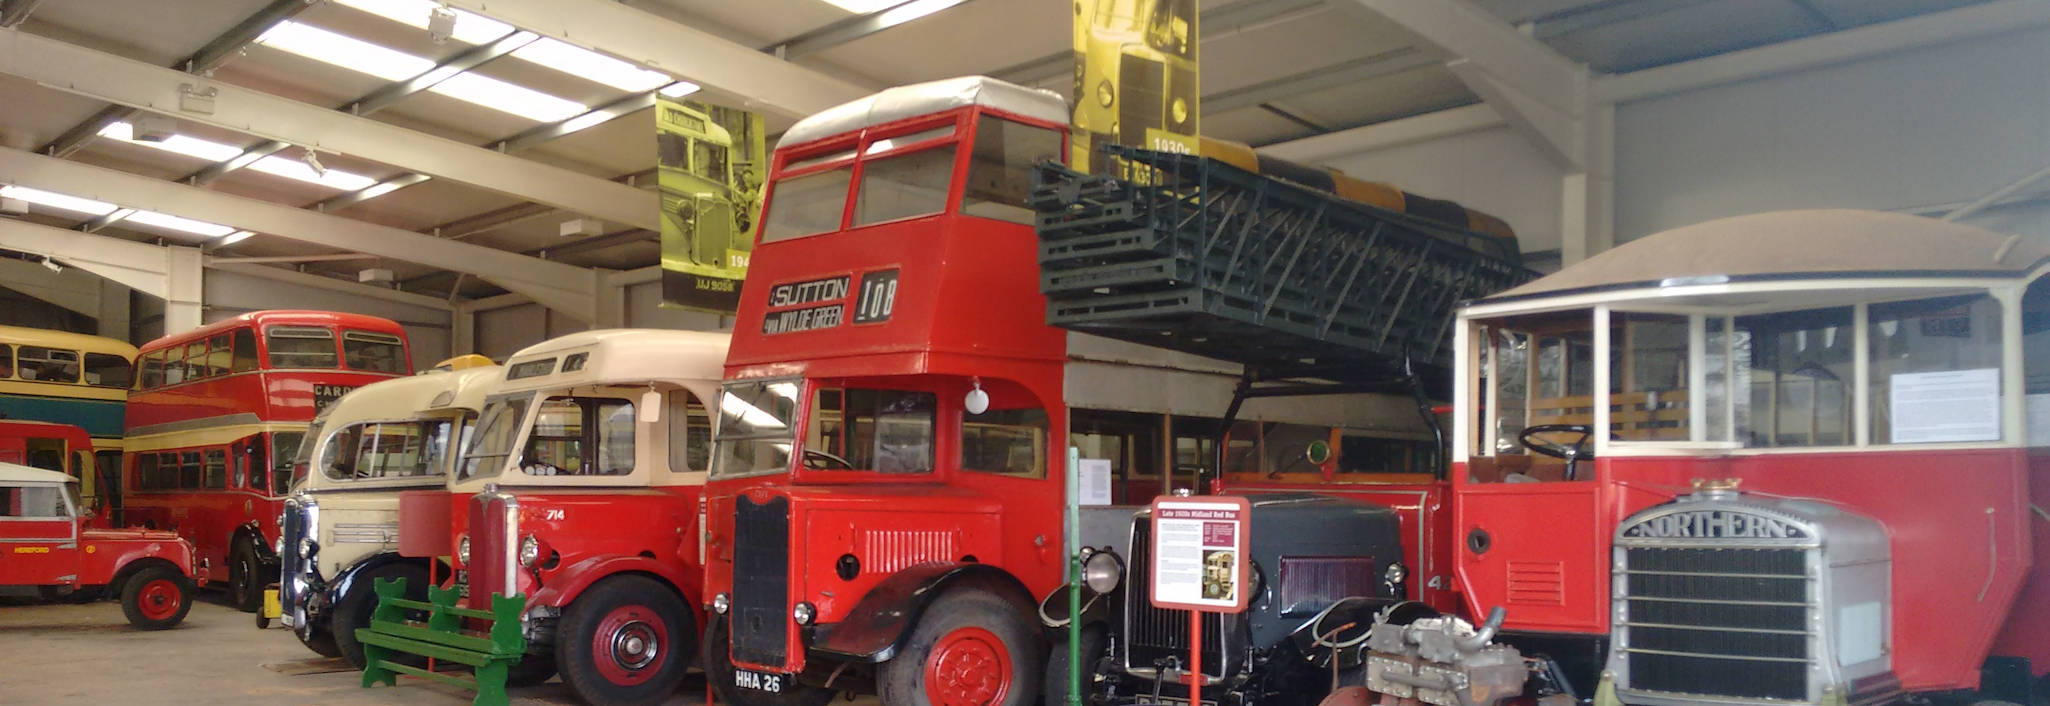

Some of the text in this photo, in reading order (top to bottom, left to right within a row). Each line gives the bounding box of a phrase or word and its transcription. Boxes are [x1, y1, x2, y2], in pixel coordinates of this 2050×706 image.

[731, 255, 750, 268] 194
[774, 278, 850, 307] SUTTON
[859, 279, 898, 319] 108
[778, 309, 812, 333] WYLDE
[811, 305, 845, 329] GREEN
[315, 385, 352, 397] CARD
[547, 509, 565, 520] 714
[1640, 510, 1788, 538] NORTHERN
[735, 670, 780, 693] HHA 26
